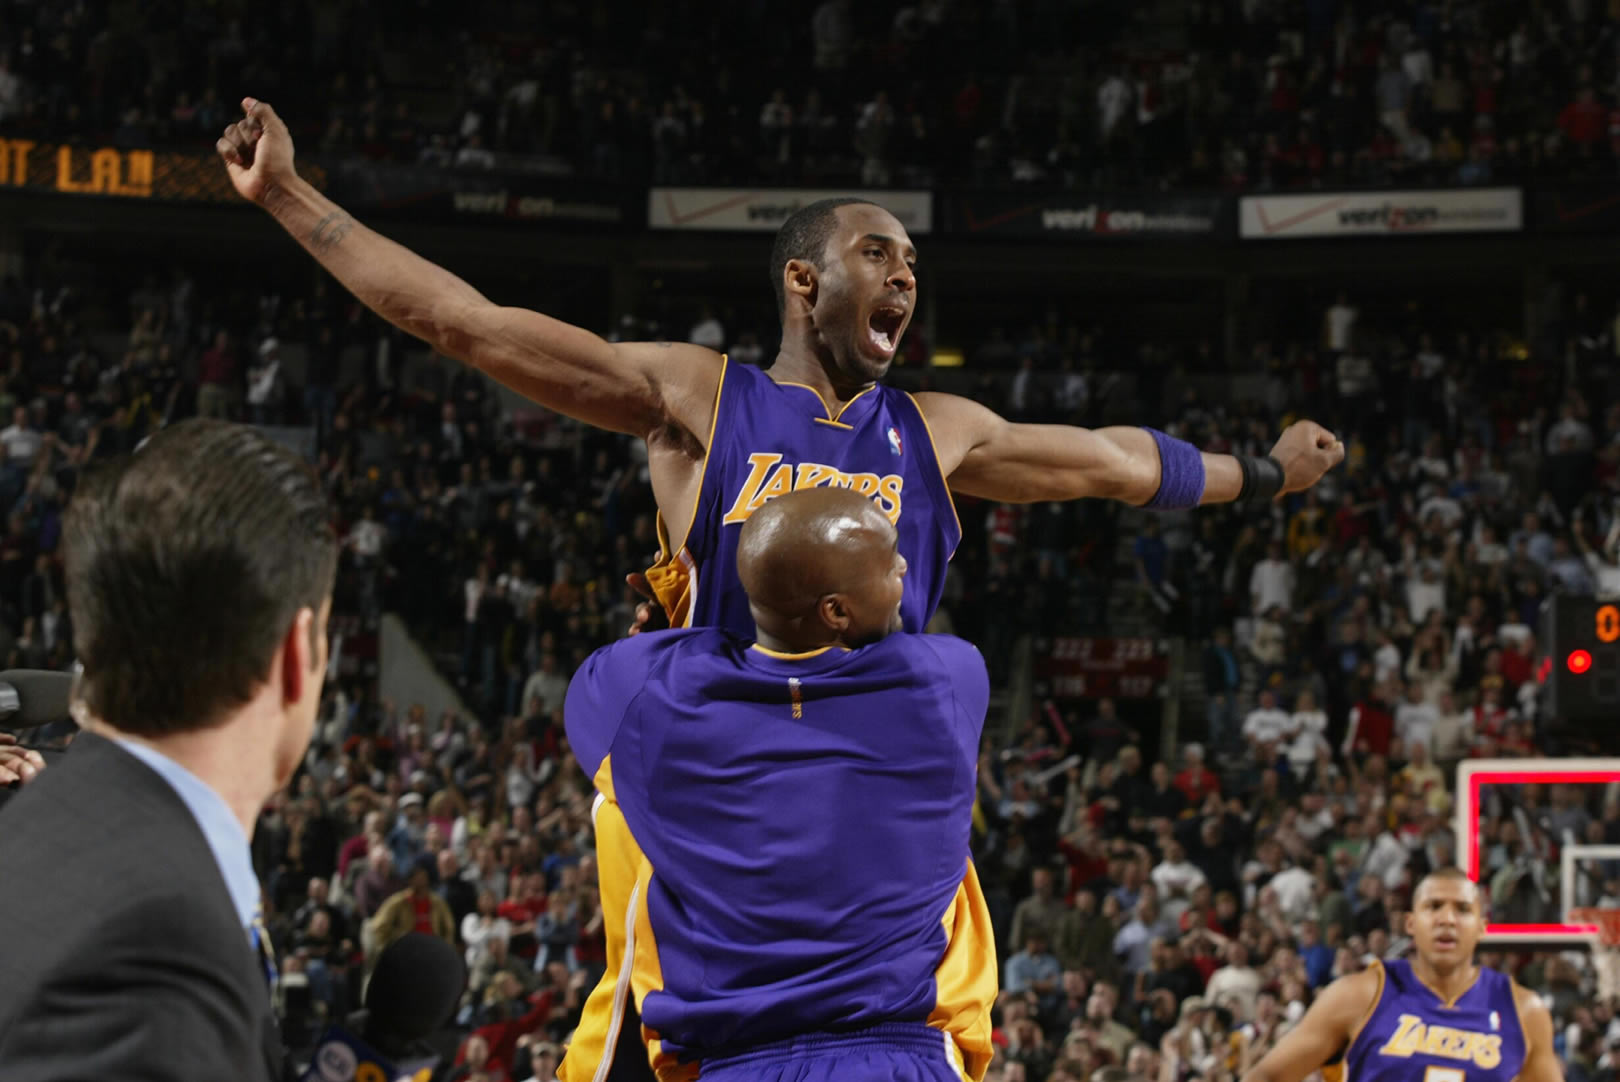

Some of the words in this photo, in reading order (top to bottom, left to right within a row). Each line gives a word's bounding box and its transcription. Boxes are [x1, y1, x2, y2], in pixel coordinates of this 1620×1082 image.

[1041, 203, 1145, 236] verizon
[1338, 202, 1439, 232] verizon
[1379, 1014, 1503, 1070] LAKERS
